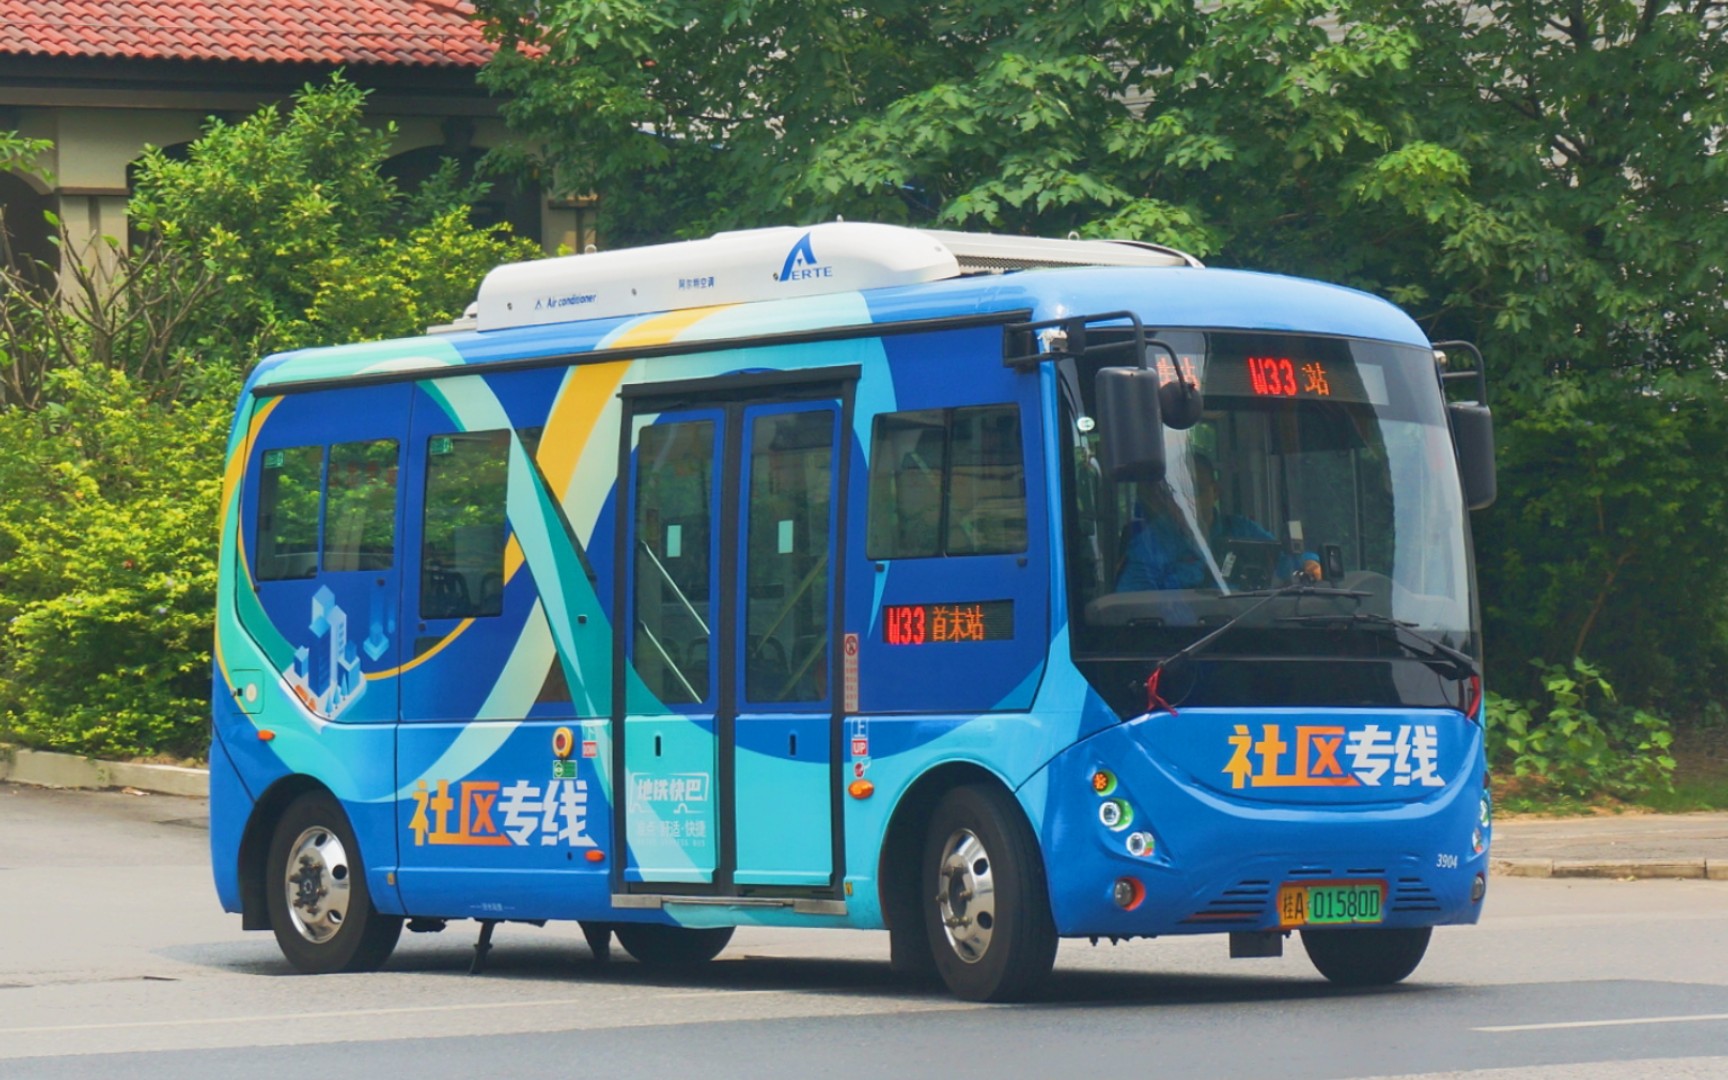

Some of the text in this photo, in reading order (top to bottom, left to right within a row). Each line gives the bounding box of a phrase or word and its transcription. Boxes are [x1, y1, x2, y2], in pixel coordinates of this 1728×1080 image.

[547, 296, 557, 308] Air
[1249, 357, 1297, 396] W33
[887, 604, 985, 646] W33 首末站
[853, 742, 866, 754] UP
[1221, 724, 1447, 789] 社区专线
[636, 778, 704, 802] 地铁快巴
[408, 779, 598, 847] 社区专线
[1436, 853, 1458, 868] 3904
[1313, 889, 1380, 919] 01580D
